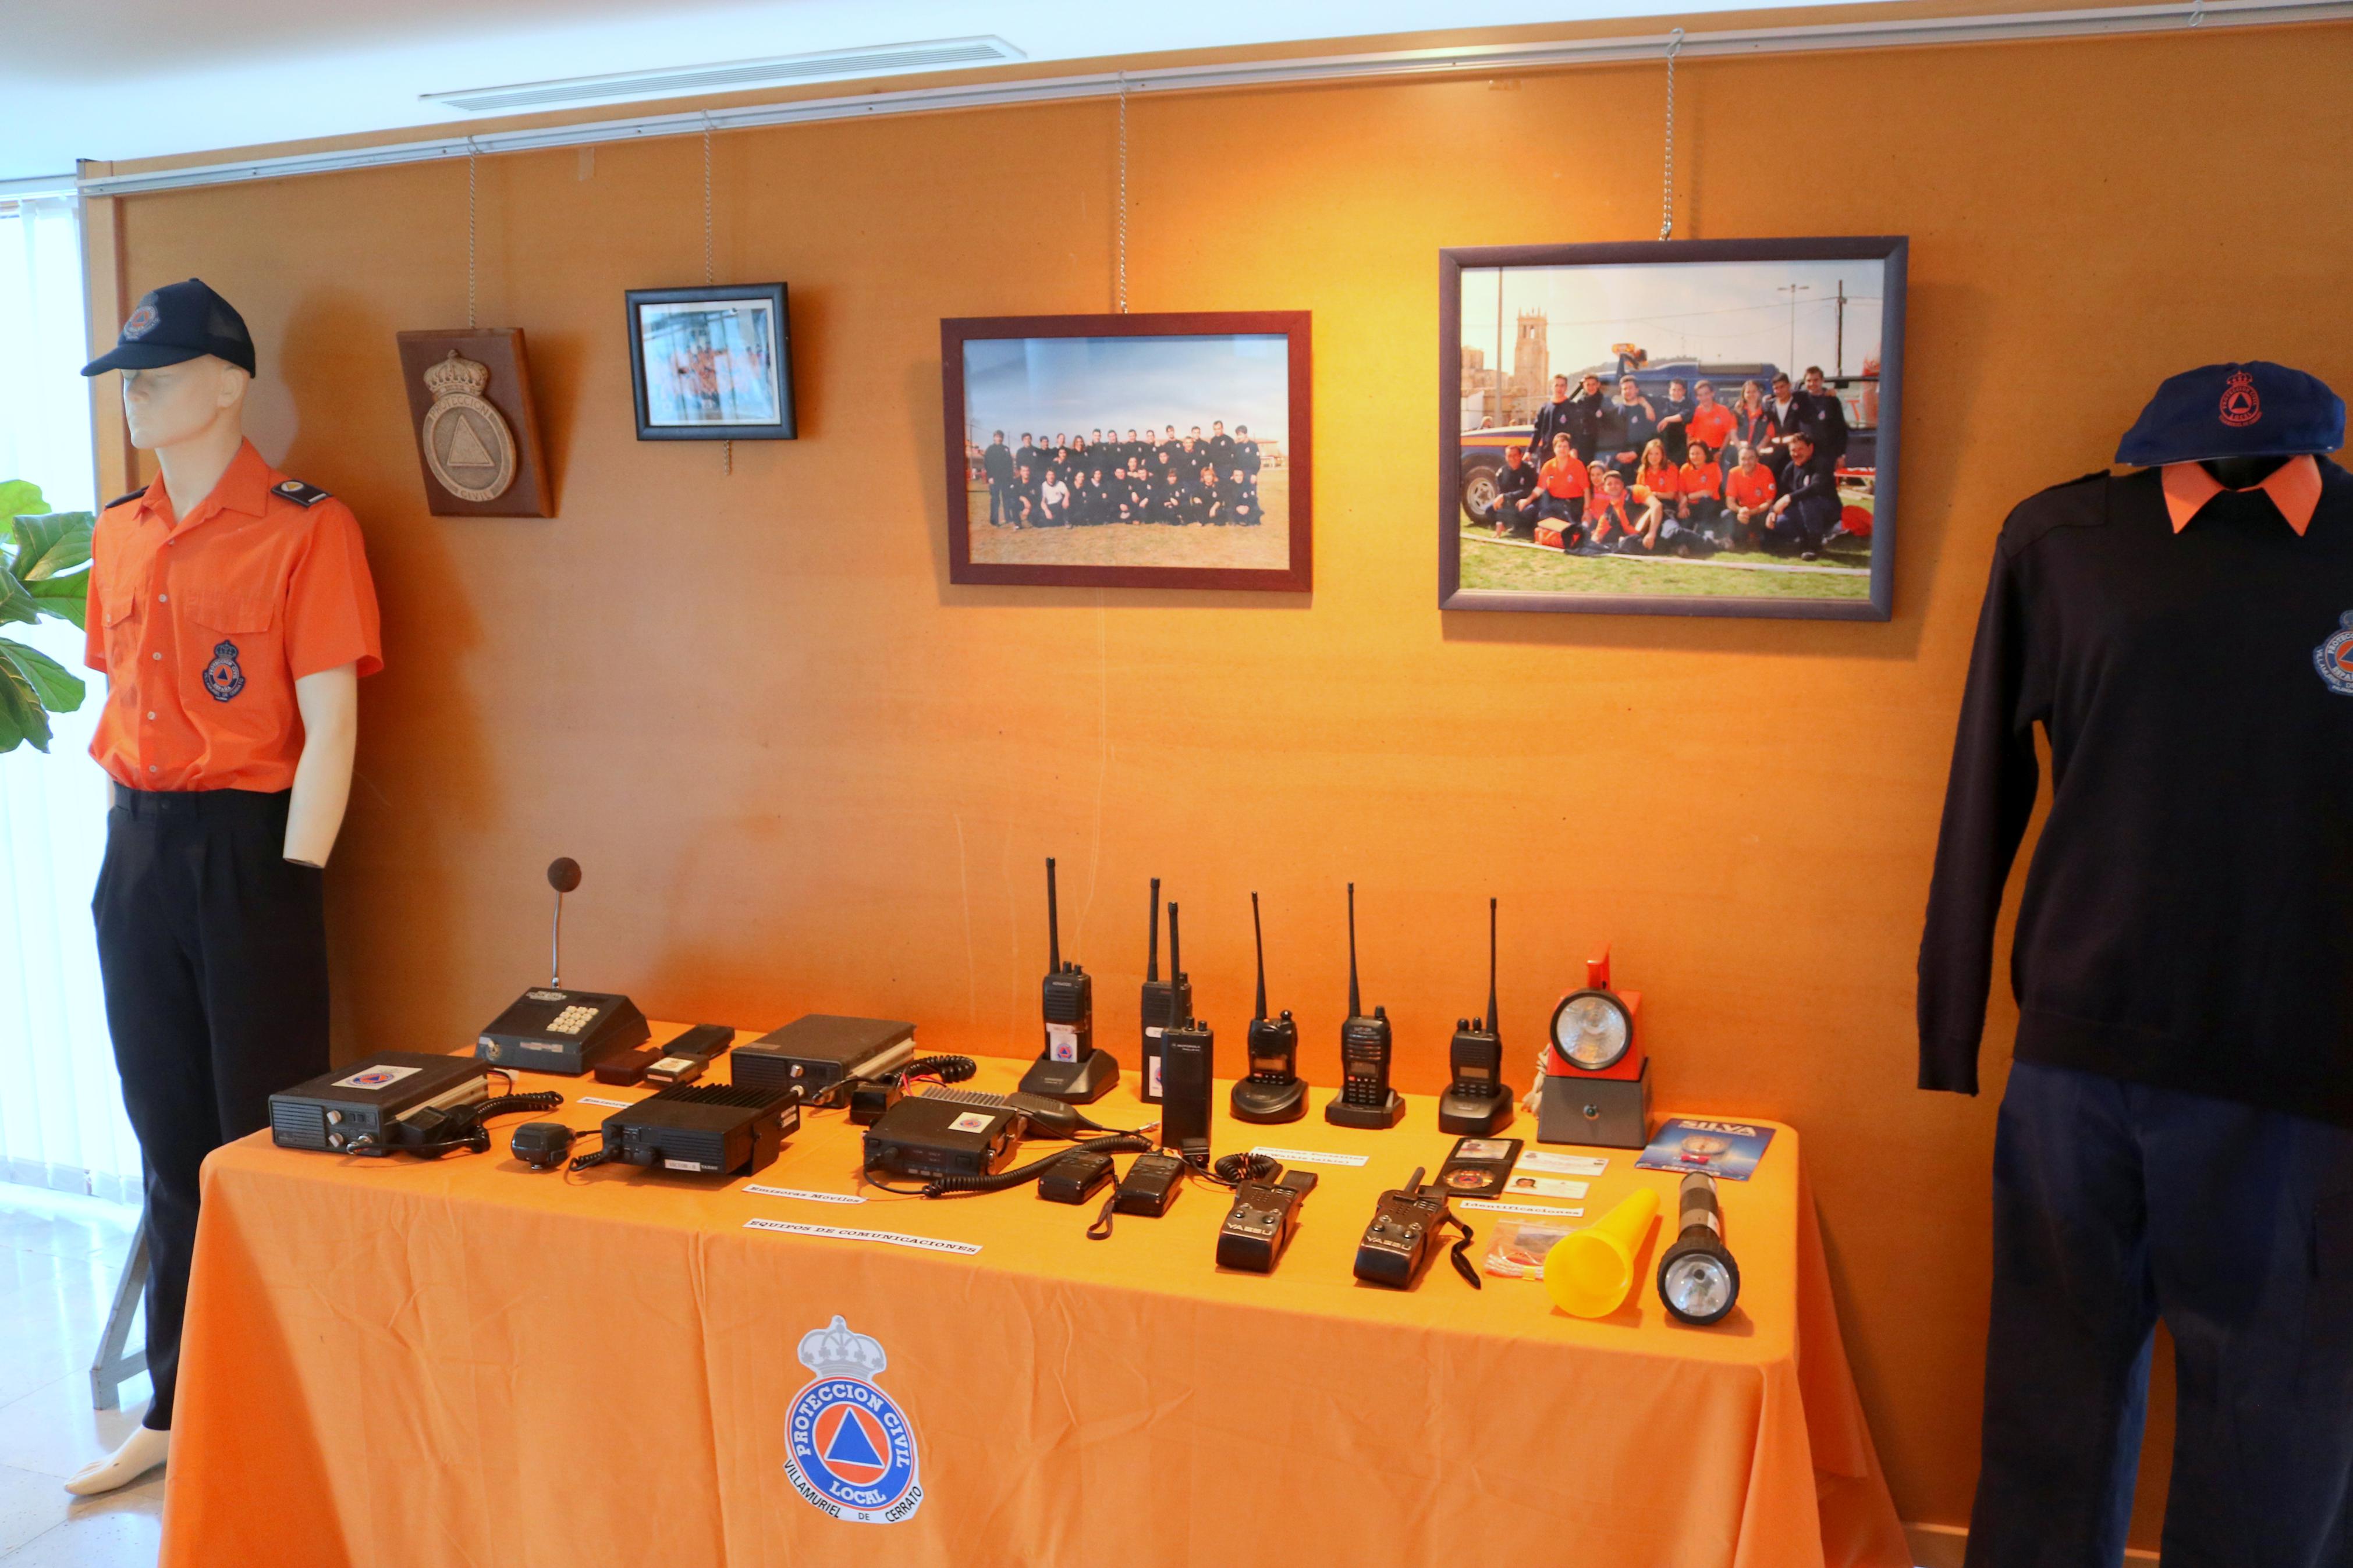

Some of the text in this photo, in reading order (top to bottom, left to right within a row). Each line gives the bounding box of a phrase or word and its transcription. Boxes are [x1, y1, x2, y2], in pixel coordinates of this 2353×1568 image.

[430, 396, 489, 419] PROTECCION
[460, 489, 492, 501] CIVIL
[1679, 1120, 1756, 1136] SILVA
[750, 1186, 806, 1196] Emisoras
[1464, 1202, 1580, 1215] Identificaciones
[750, 1220, 810, 1231] EQUIPOS
[839, 1229, 977, 1253] COMUNICACIONES
[1227, 1222, 1273, 1236] YAESU
[1367, 1235, 1412, 1251] YAESU
[794, 1384, 910, 1469] PROTECCION CIVIL
[784, 1459, 922, 1523] VILLAMURIEL DE CERRATO
[829, 1480, 886, 1505] LOCAL
